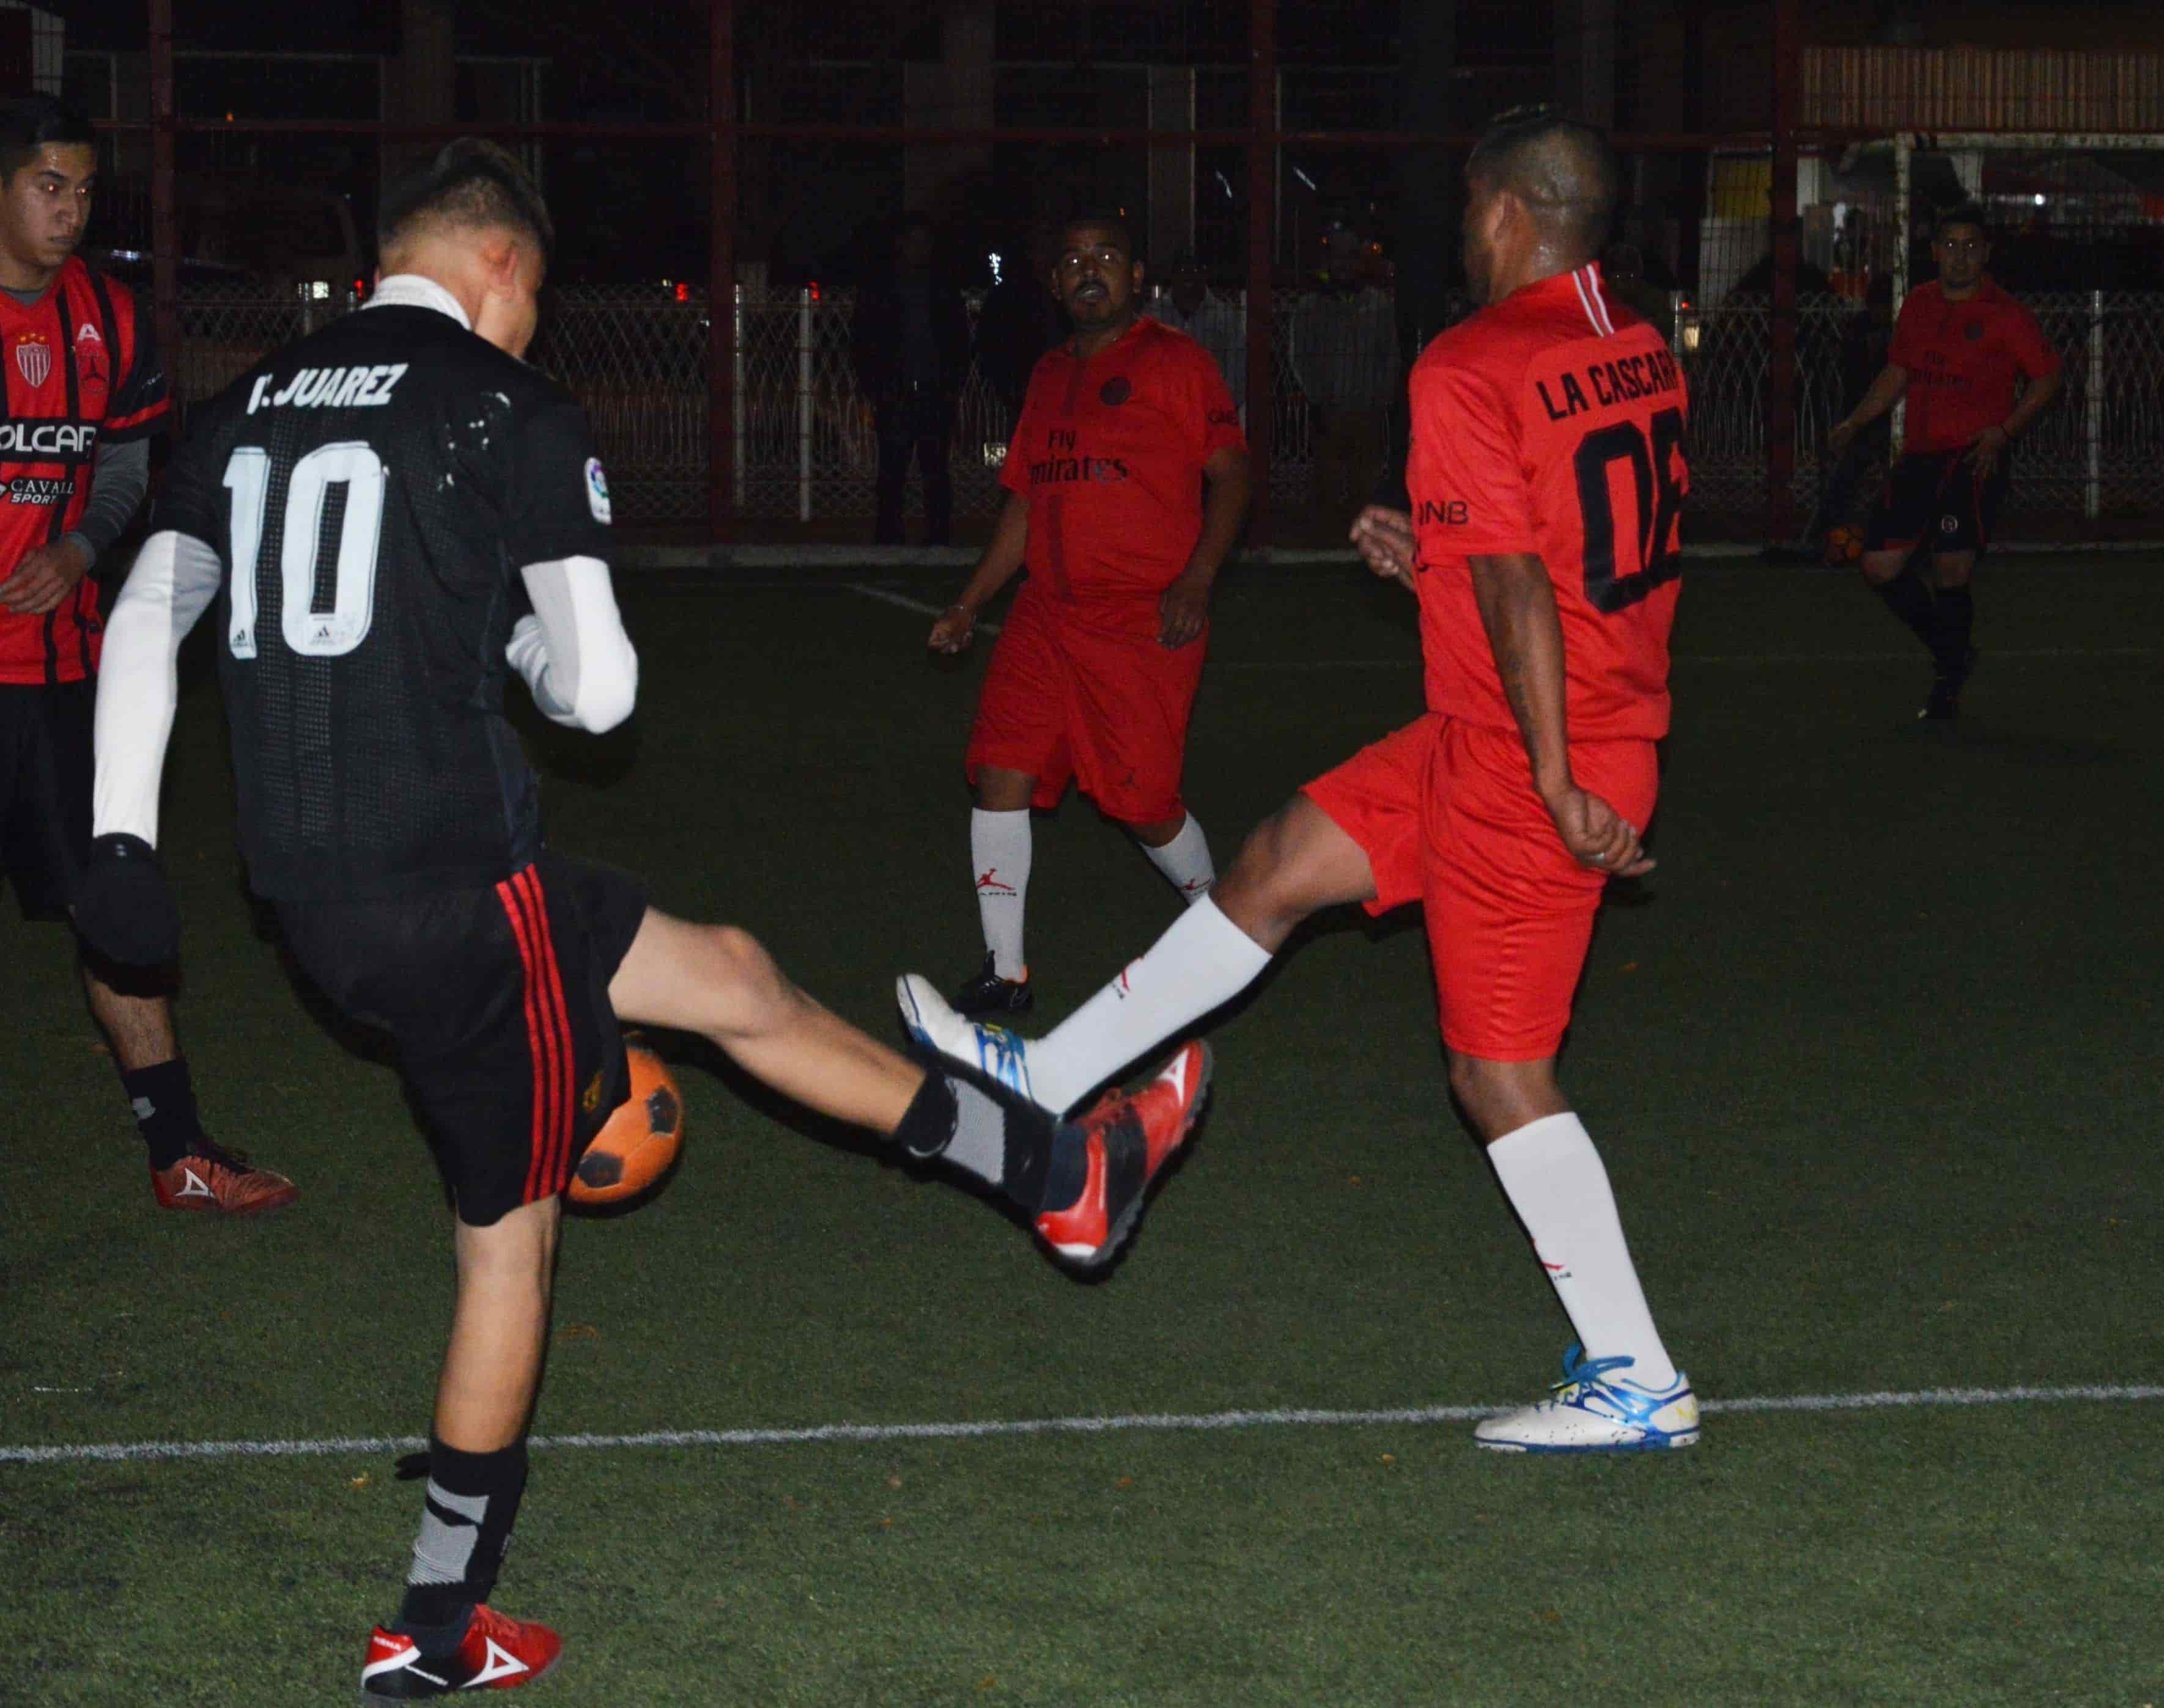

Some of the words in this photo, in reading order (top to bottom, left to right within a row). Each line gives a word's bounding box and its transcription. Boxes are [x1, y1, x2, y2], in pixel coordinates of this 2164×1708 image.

[1536, 374, 1590, 421] LA
[11, 493, 57, 505] SPORT
[223, 440, 390, 659] 10
